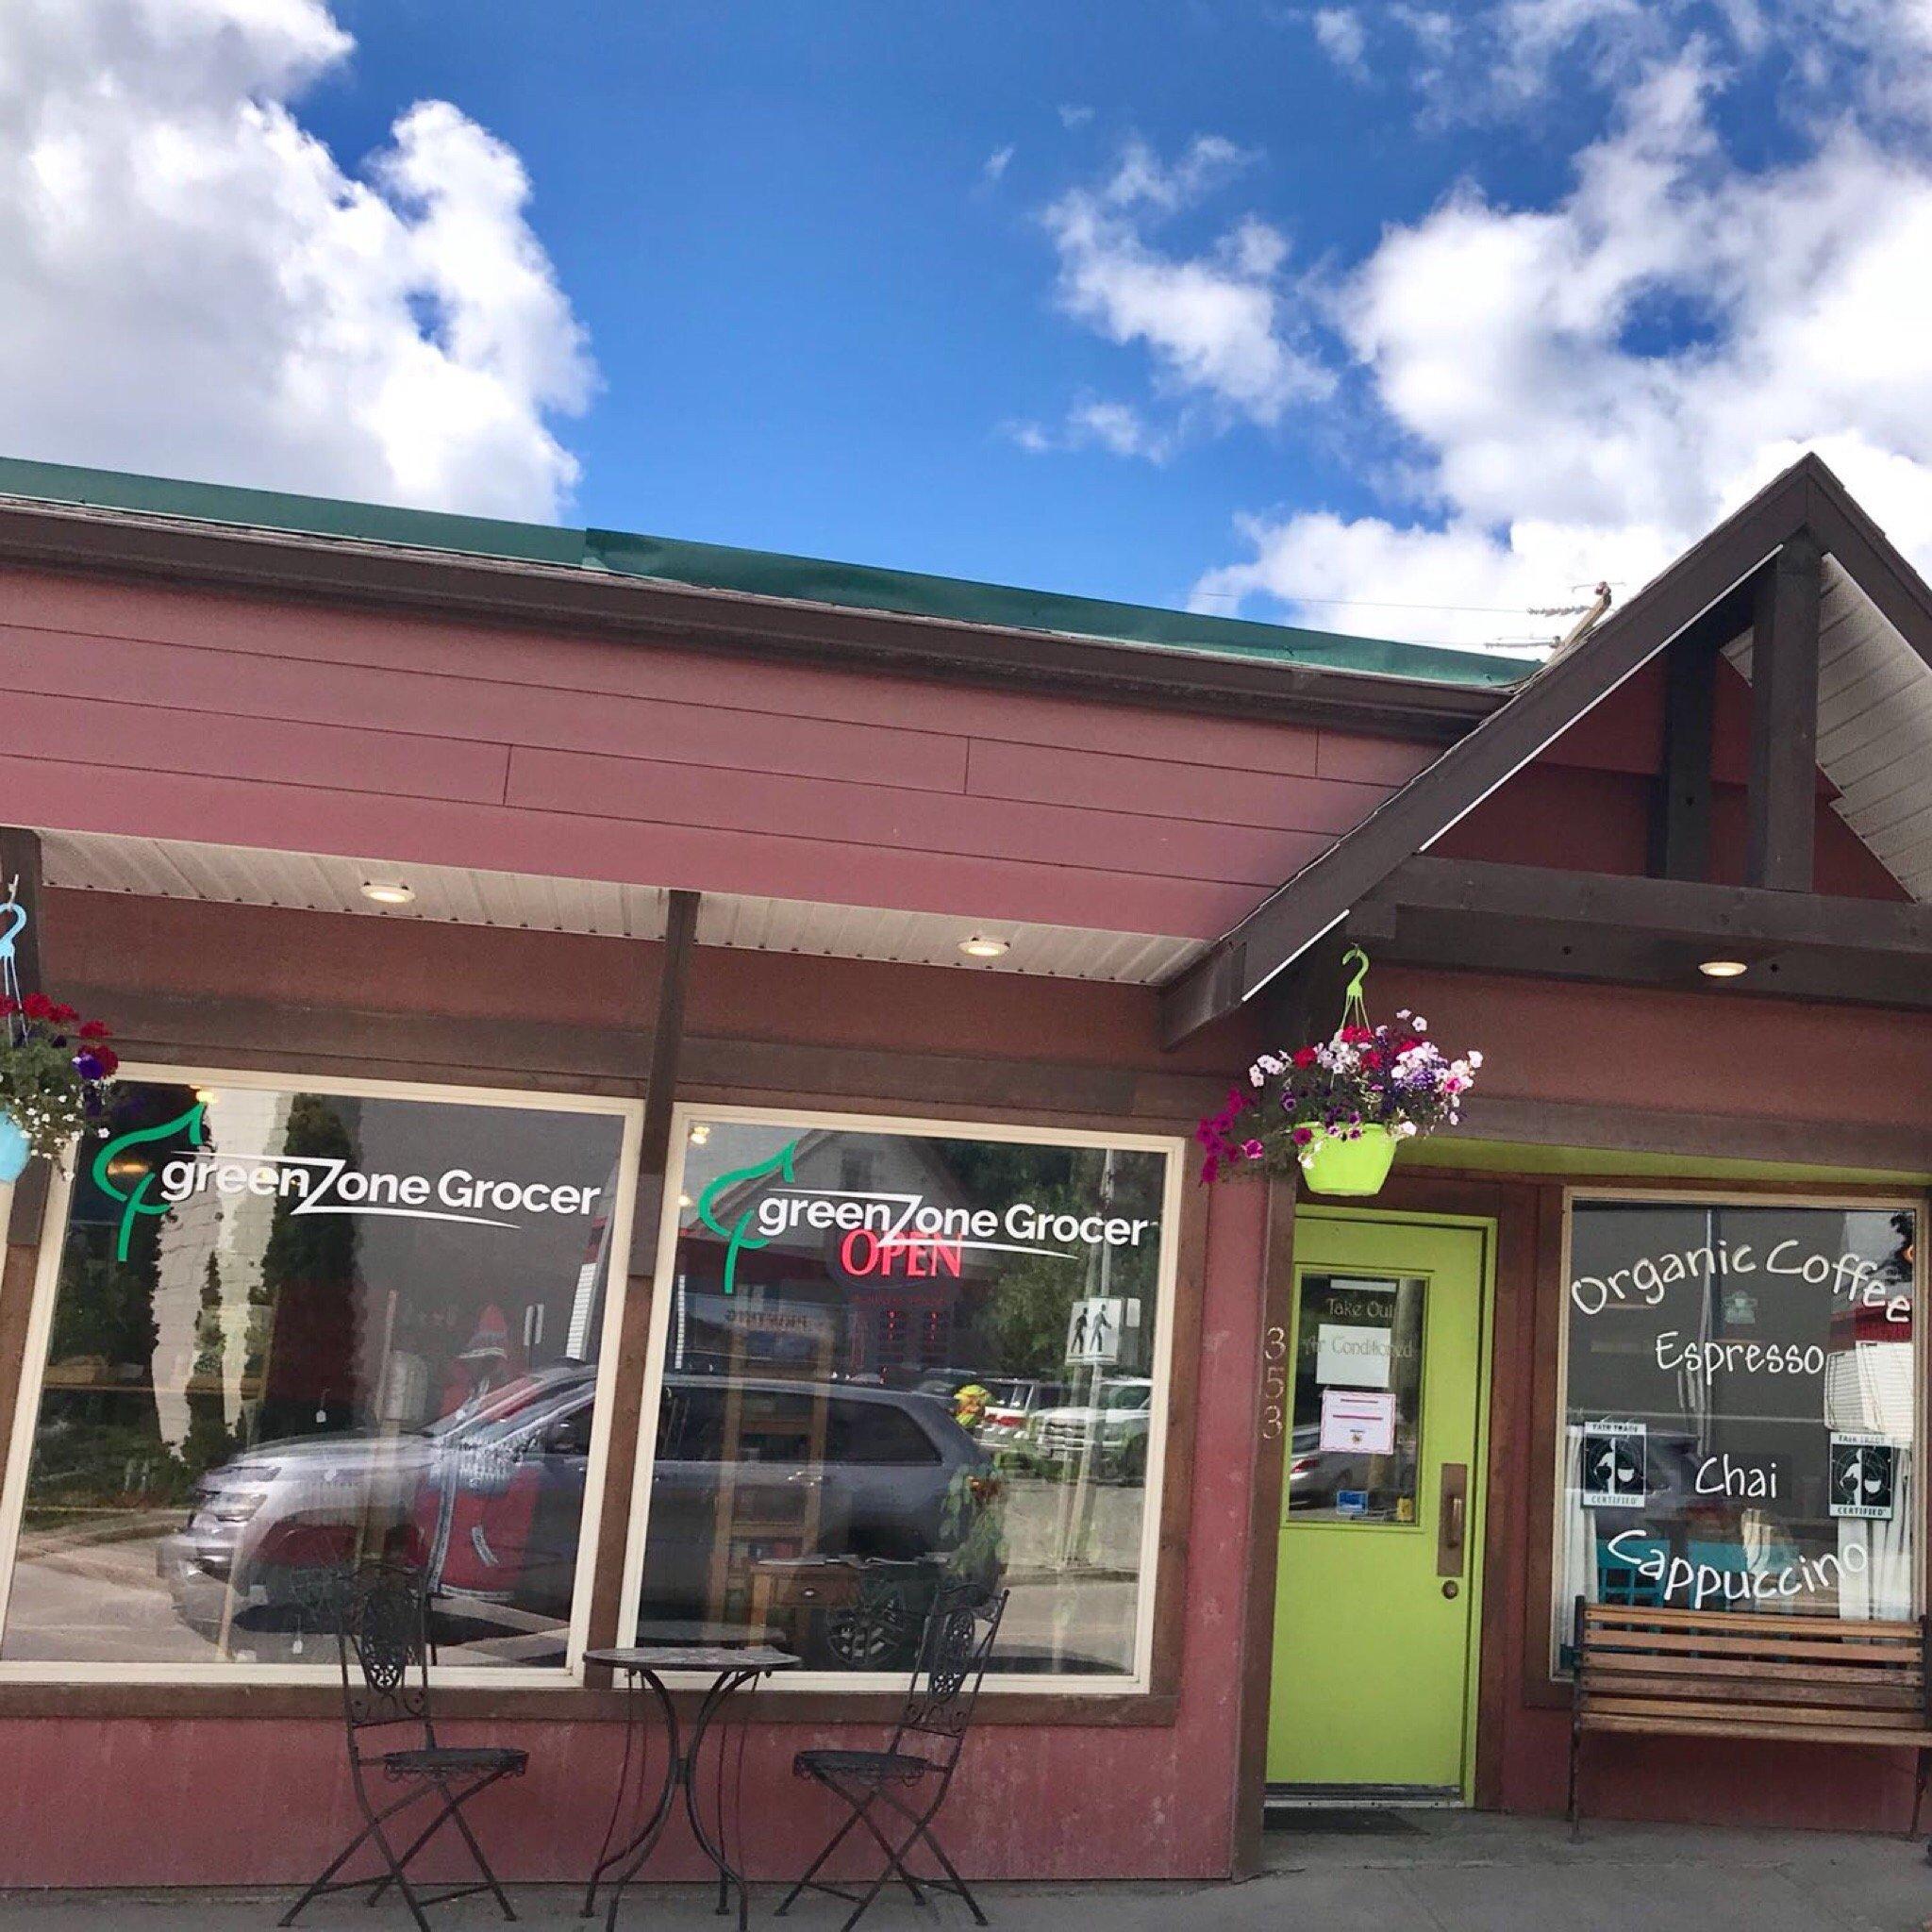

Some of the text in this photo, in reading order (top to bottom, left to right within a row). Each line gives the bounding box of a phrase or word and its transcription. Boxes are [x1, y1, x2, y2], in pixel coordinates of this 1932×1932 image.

[439, 1169, 602, 1215] Grocer
[1005, 1203, 1149, 1246] Grocer
[840, 1229, 963, 1278] OPEN
[1571, 1239, 1911, 1323] Organic Coffee
[1325, 1297, 1362, 1317] Take
[1655, 1330, 1826, 1386] Espresso
[1263, 1326, 1286, 1440] 353
[1694, 1453, 1778, 1499] Chai
[1607, 1528, 1869, 1610] Cappuccino
